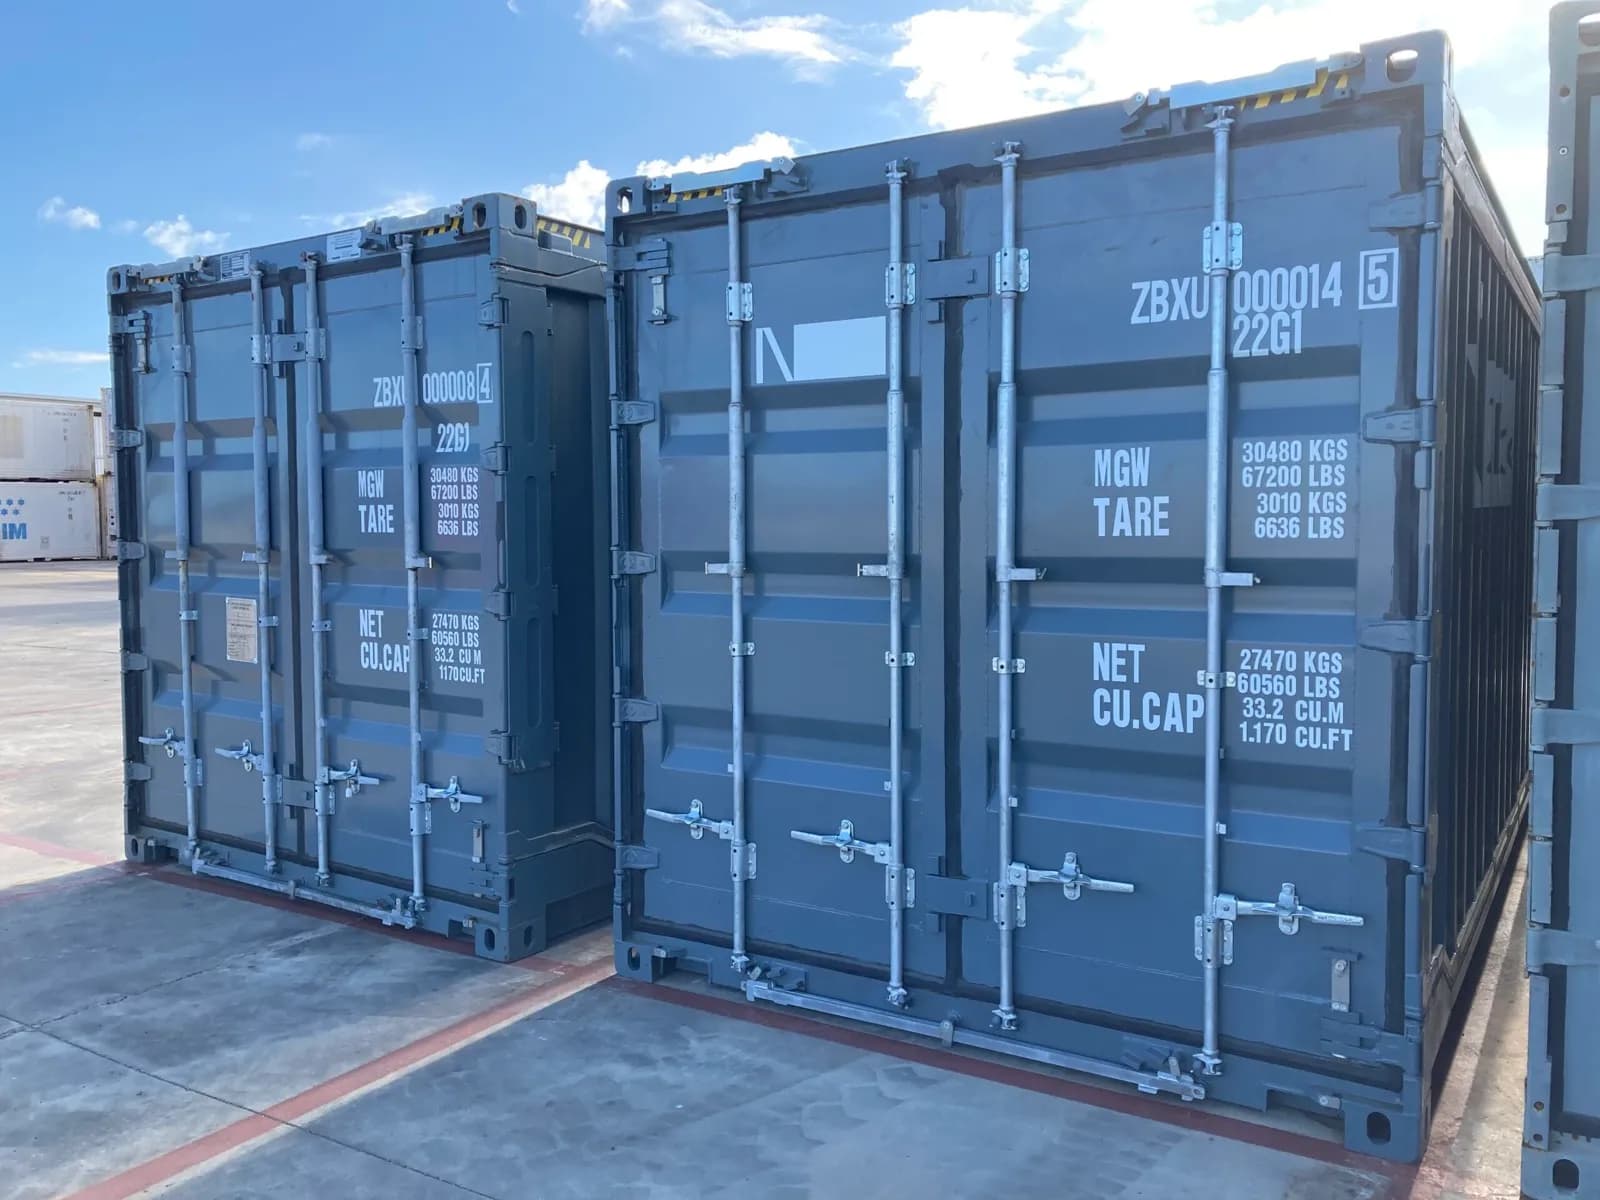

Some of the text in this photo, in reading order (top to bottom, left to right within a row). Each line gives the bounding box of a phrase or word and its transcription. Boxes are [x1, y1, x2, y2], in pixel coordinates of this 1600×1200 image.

[1130, 252, 1391, 325] ZBXU 000014 5
[1232, 310, 1302, 358] 22G1
[436, 422, 470, 453] 22G1
[1242, 438, 1348, 463] 30480 KGS
[430, 467, 479, 483] 30480 KGS
[1094, 446, 1150, 488] MGW
[1241, 464, 1345, 488] 67200 LBS
[358, 469, 384, 499] MGW
[431, 485, 479, 500] 67200 LBS
[438, 503, 479, 519] 3010 KGS
[1093, 495, 1170, 537] TARE
[1257, 491, 1347, 514] 3010 KGS
[358, 504, 395, 533] TARE
[437, 521, 479, 537] 6636 LBS
[1254, 516, 1345, 539] 6636 LBS
[359, 608, 385, 639] NET
[432, 613, 479, 631] 27470 KGS
[431, 630, 479, 648] 60560 LBS
[434, 647, 454, 663] 33.2
[1092, 642, 1145, 684] NET
[1240, 649, 1342, 675] 27470 KGS
[1237, 672, 1340, 699] 60560 LBS
[1093, 687, 1205, 734] CU.CAP
[1242, 697, 1344, 724] 33.2 CU.M
[1239, 722, 1353, 751] 1.170 CU.FT
